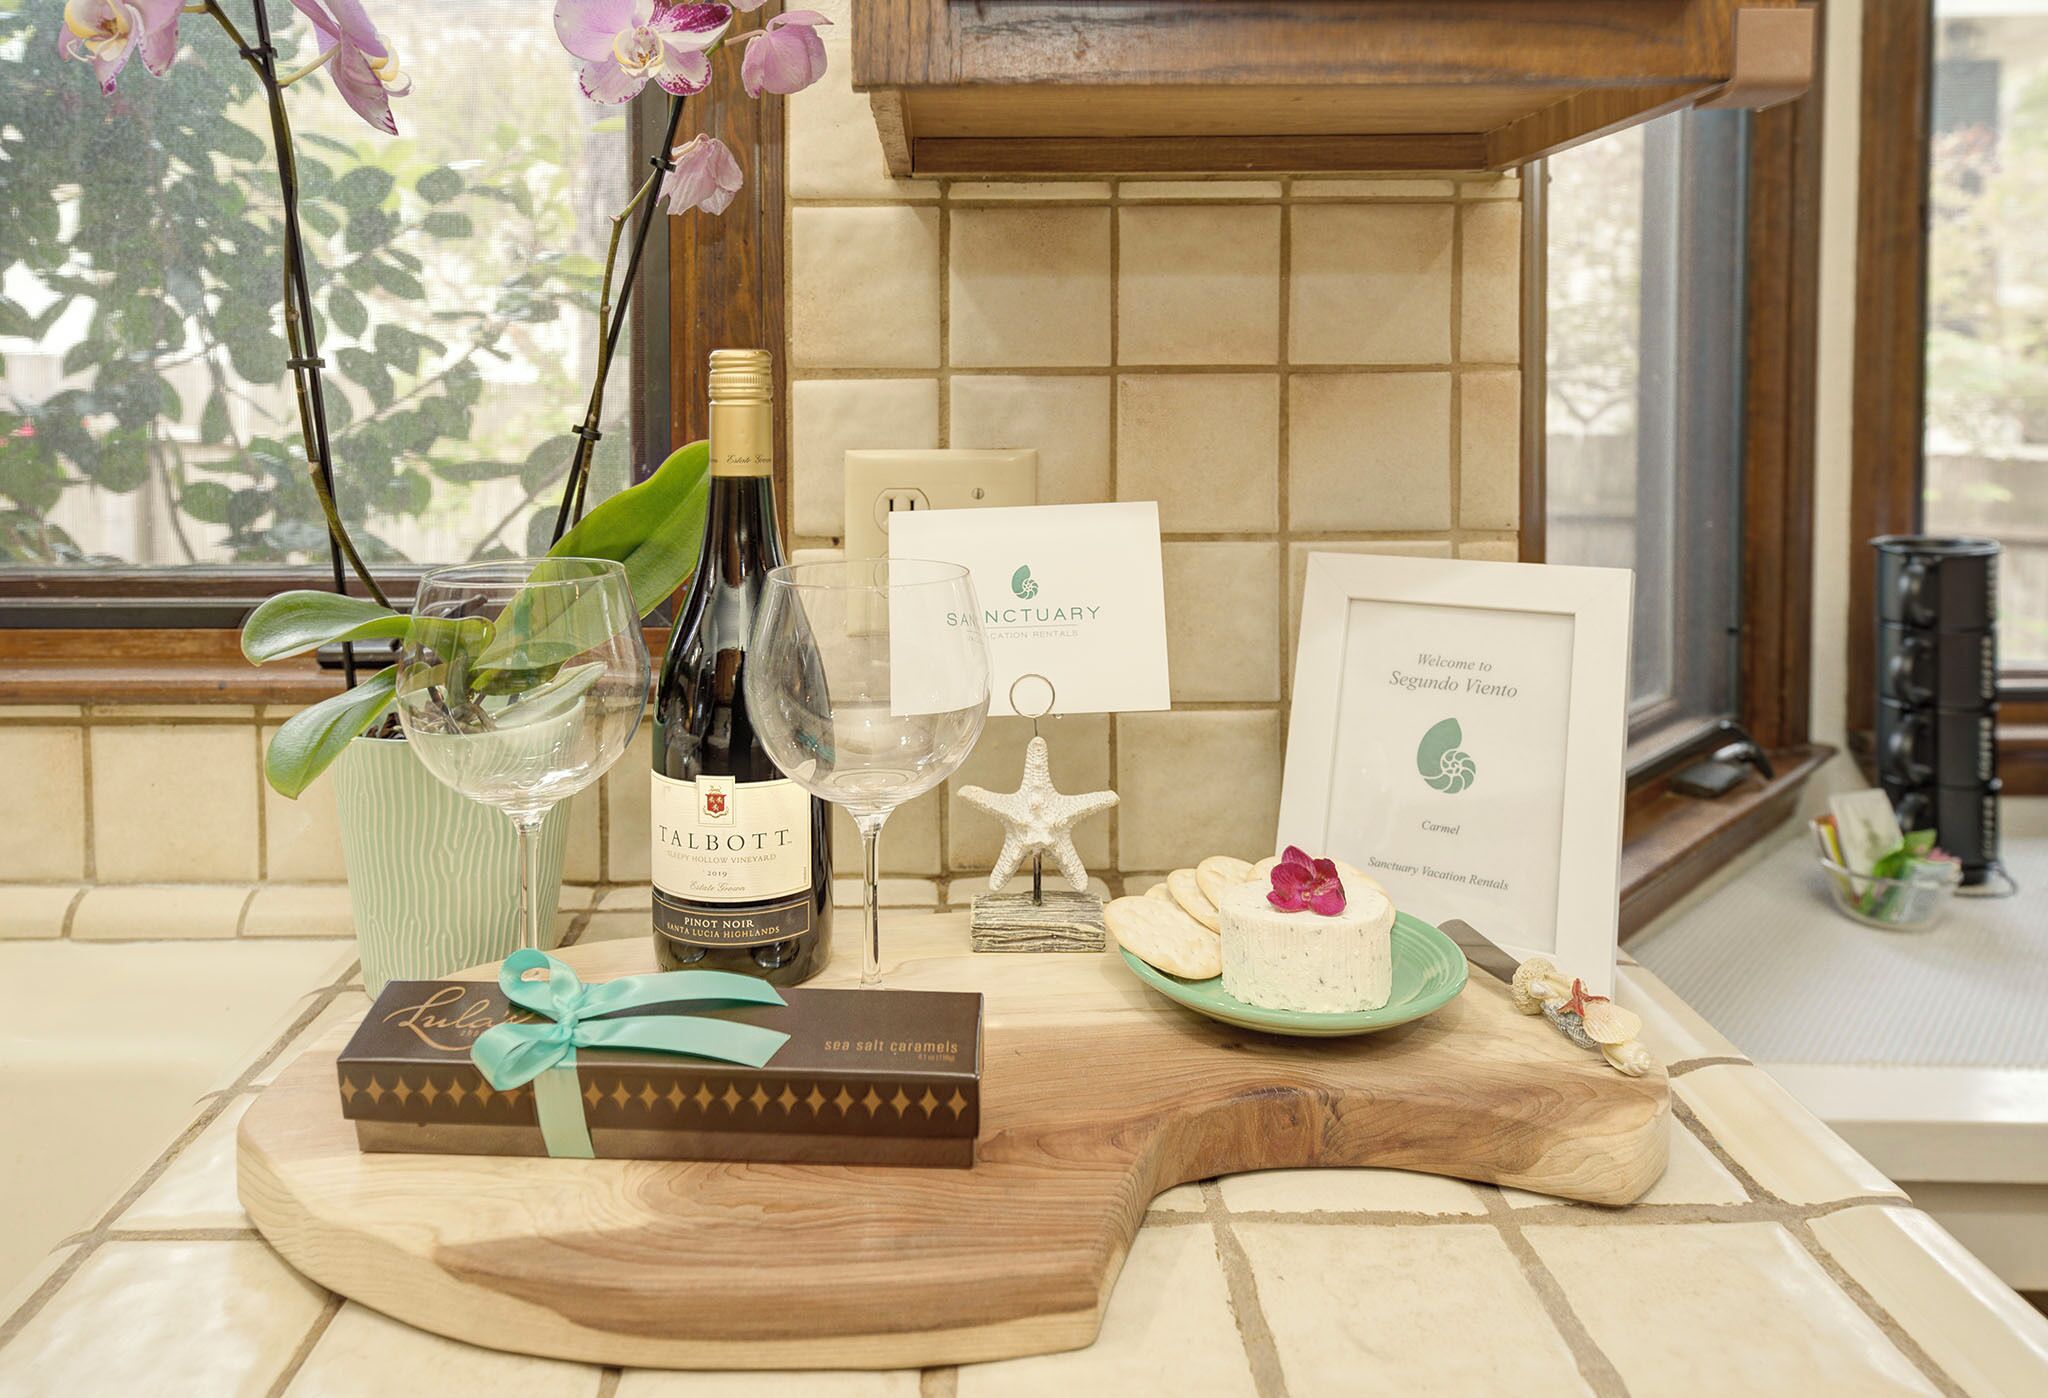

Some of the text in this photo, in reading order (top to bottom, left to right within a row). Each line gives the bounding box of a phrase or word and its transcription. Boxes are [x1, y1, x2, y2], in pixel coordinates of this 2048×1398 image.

[1032, 630, 1079, 639] RENTALS
[1418, 653, 1493, 672] Welcome to
[1389, 670, 1518, 698] Segundo Viento
[1421, 820, 1461, 835] Carmel
[658, 824, 789, 851] TALBOTT
[691, 856, 729, 864] HOLLOW
[730, 854, 777, 864] VINEYARD
[1367, 856, 1509, 890] Sanctuary Vacation Rentals
[689, 880, 746, 892] Estate Grown
[667, 921, 780, 938] SANTA LUCIA HIGHLANDS
[684, 916, 755, 928] PINOT NOIR
[824, 1039, 959, 1053] sea salt caramels
